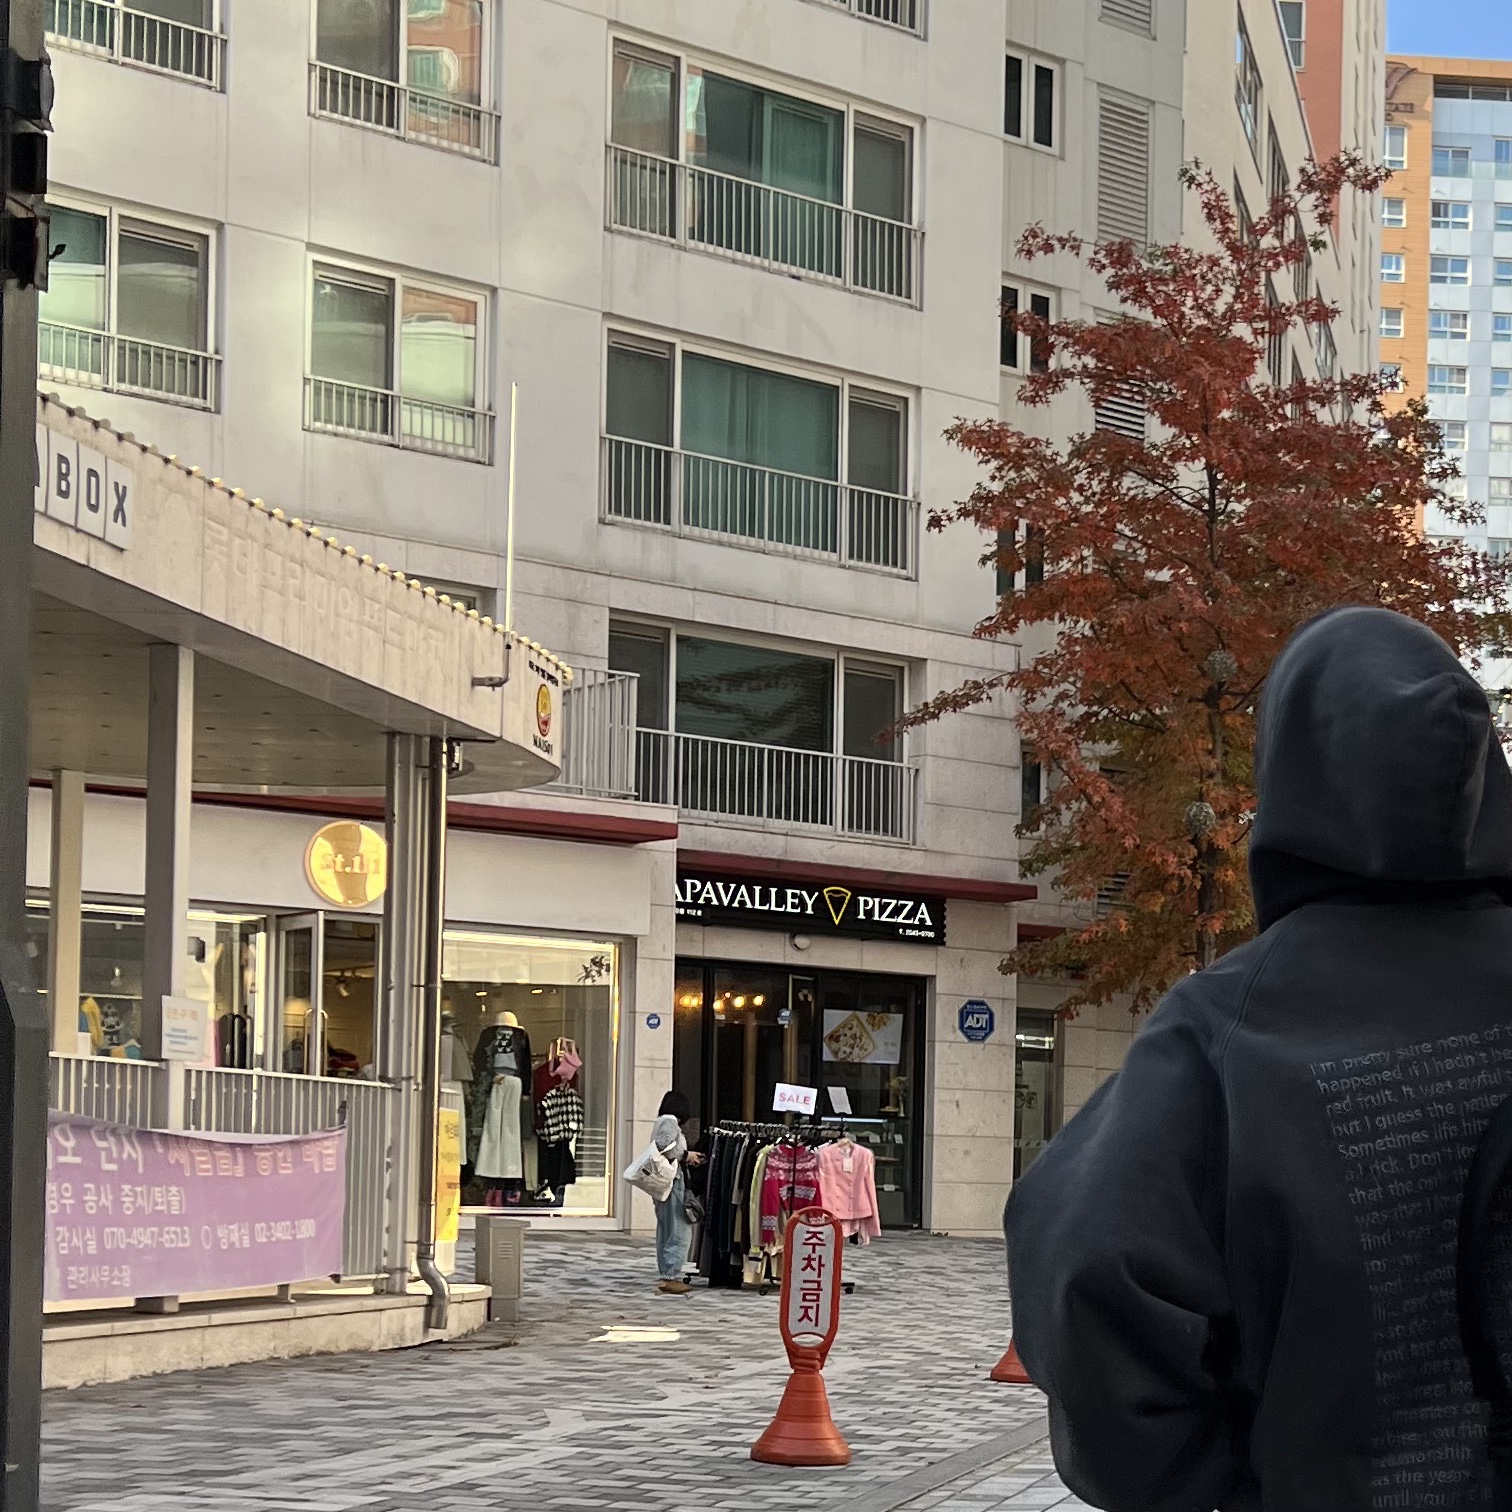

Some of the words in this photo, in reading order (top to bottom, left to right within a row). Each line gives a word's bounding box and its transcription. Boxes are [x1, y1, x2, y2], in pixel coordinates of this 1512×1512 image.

[56, 453, 127, 527] BOX
[857, 896, 932, 925] PIZZA
[964, 1013, 989, 1028] ADT
[1436, 1032, 1480, 1051] none
[1483, 1023, 1500, 1041] of
[1316, 1065, 1403, 1094] happened
[779, 1092, 811, 1105] SALE
[1325, 1095, 1352, 1117] red
[1419, 1079, 1453, 1096] was
[1426, 1101, 1455, 1119] the
[1338, 1129, 1430, 1159] Sometimes
[83, 1183, 113, 1215] 공사
[797, 1230, 827, 1328] 주차금지
